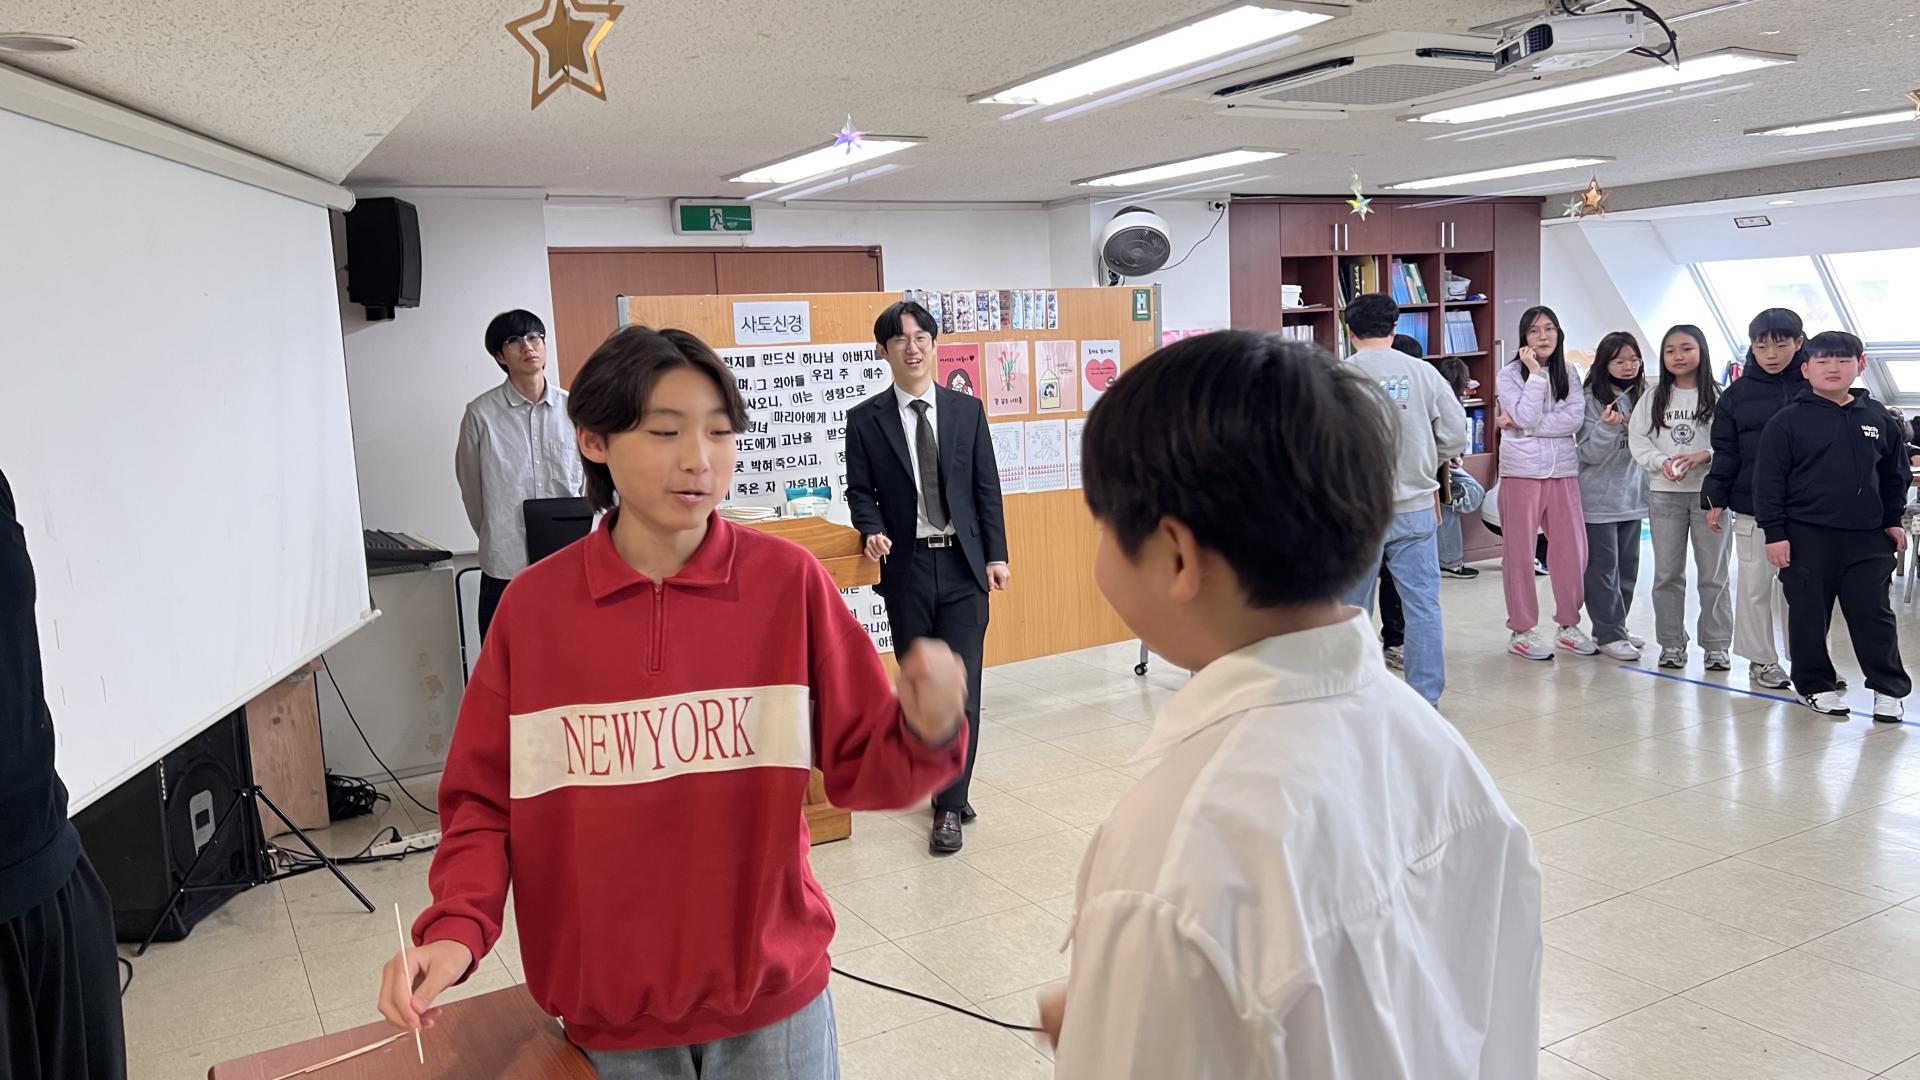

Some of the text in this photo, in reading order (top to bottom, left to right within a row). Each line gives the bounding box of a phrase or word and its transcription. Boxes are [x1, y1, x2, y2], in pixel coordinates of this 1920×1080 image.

[740, 314, 803, 334] 사도신경
[763, 351, 795, 365] 만드신
[802, 351, 834, 365] 하나님
[757, 379, 767, 390] 그
[773, 375, 805, 389] 외아들
[812, 368, 833, 381] 우리
[839, 368, 849, 380] 주
[863, 367, 884, 380] 예수
[792, 390, 813, 404] 이는
[824, 384, 867, 401] 성령으로
[774, 411, 827, 424] 마리아에게
[781, 432, 813, 446] 고난을
[751, 459, 773, 472] 박혀
[775, 453, 822, 469] 죽으시고,
[737, 482, 760, 495] 죽은
[765, 481, 776, 493] 자
[561, 695, 756, 776] NEWYORK
